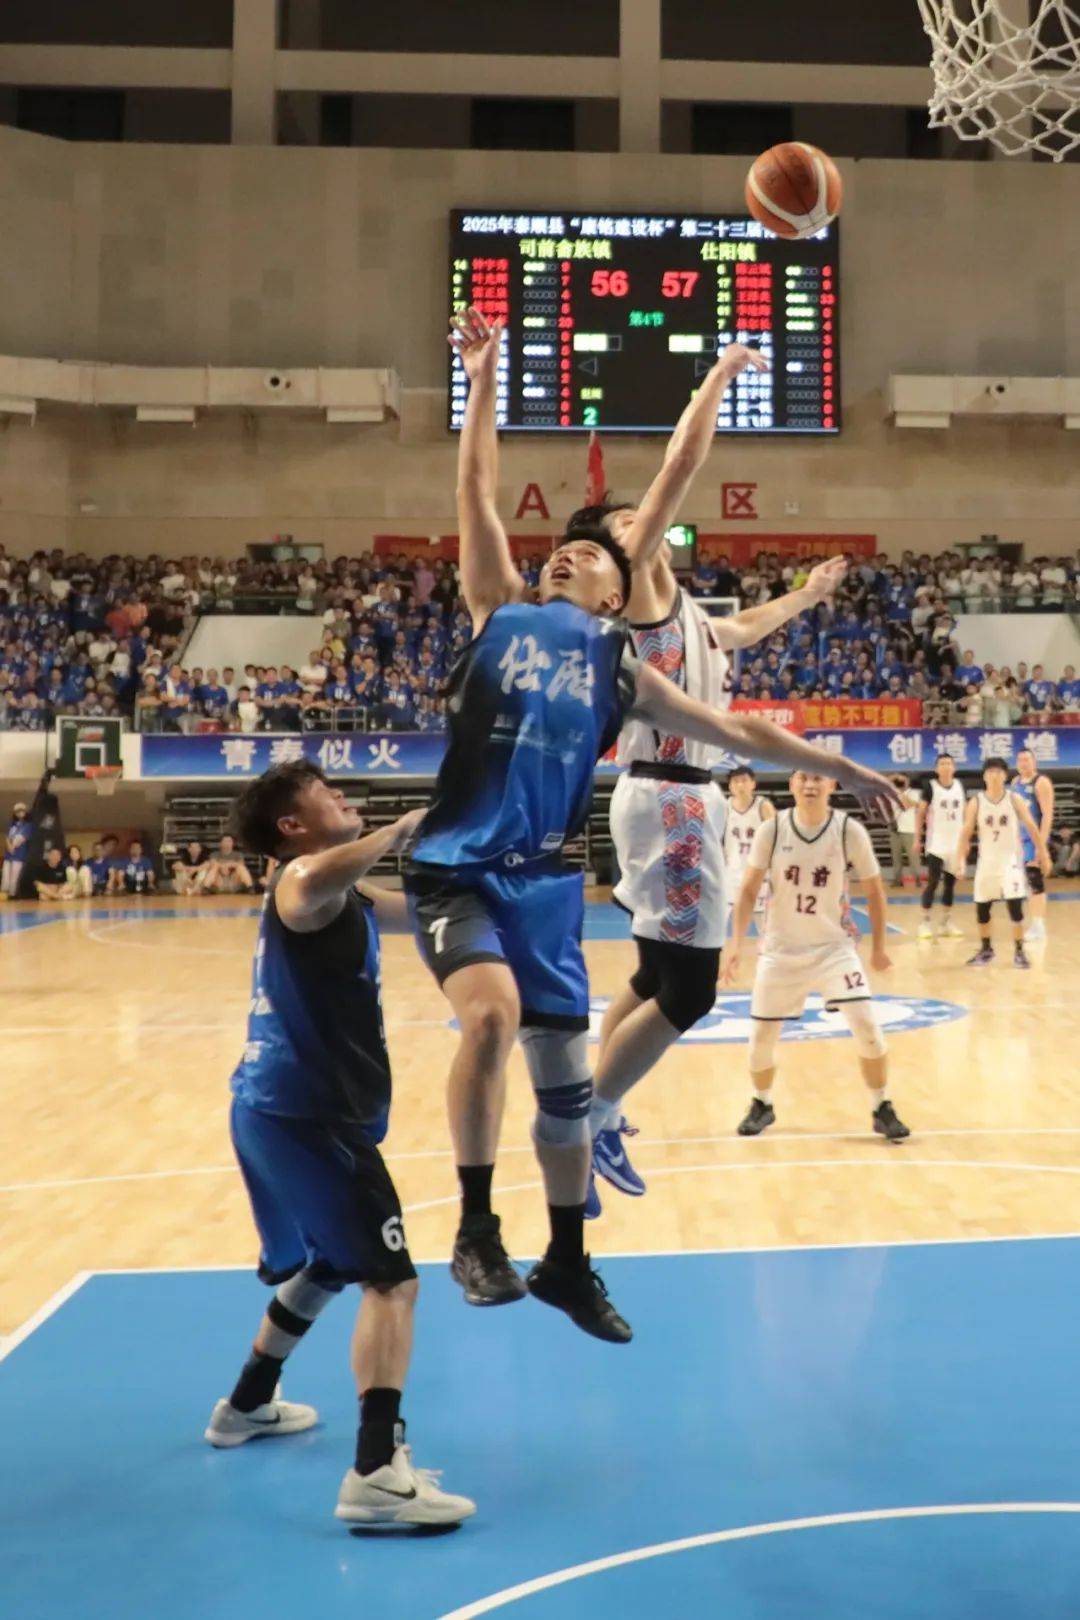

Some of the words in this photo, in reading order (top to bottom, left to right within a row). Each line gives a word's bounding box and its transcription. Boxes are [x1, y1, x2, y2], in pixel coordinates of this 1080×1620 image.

[700, 242, 756, 261] 仕阳镇
[591, 270, 628, 297] 56
[662, 271, 699, 298] 57
[583, 406, 598, 426] 2
[514, 483, 550, 519] A
[721, 482, 758, 519] 区
[220, 738, 401, 771] 青春似火
[888, 731, 1058, 764] 创造辉煌
[993, 831, 1001, 842] 7
[785, 864, 831, 887] 司前
[796, 893, 818, 914] 12
[844, 971, 865, 991] 12
